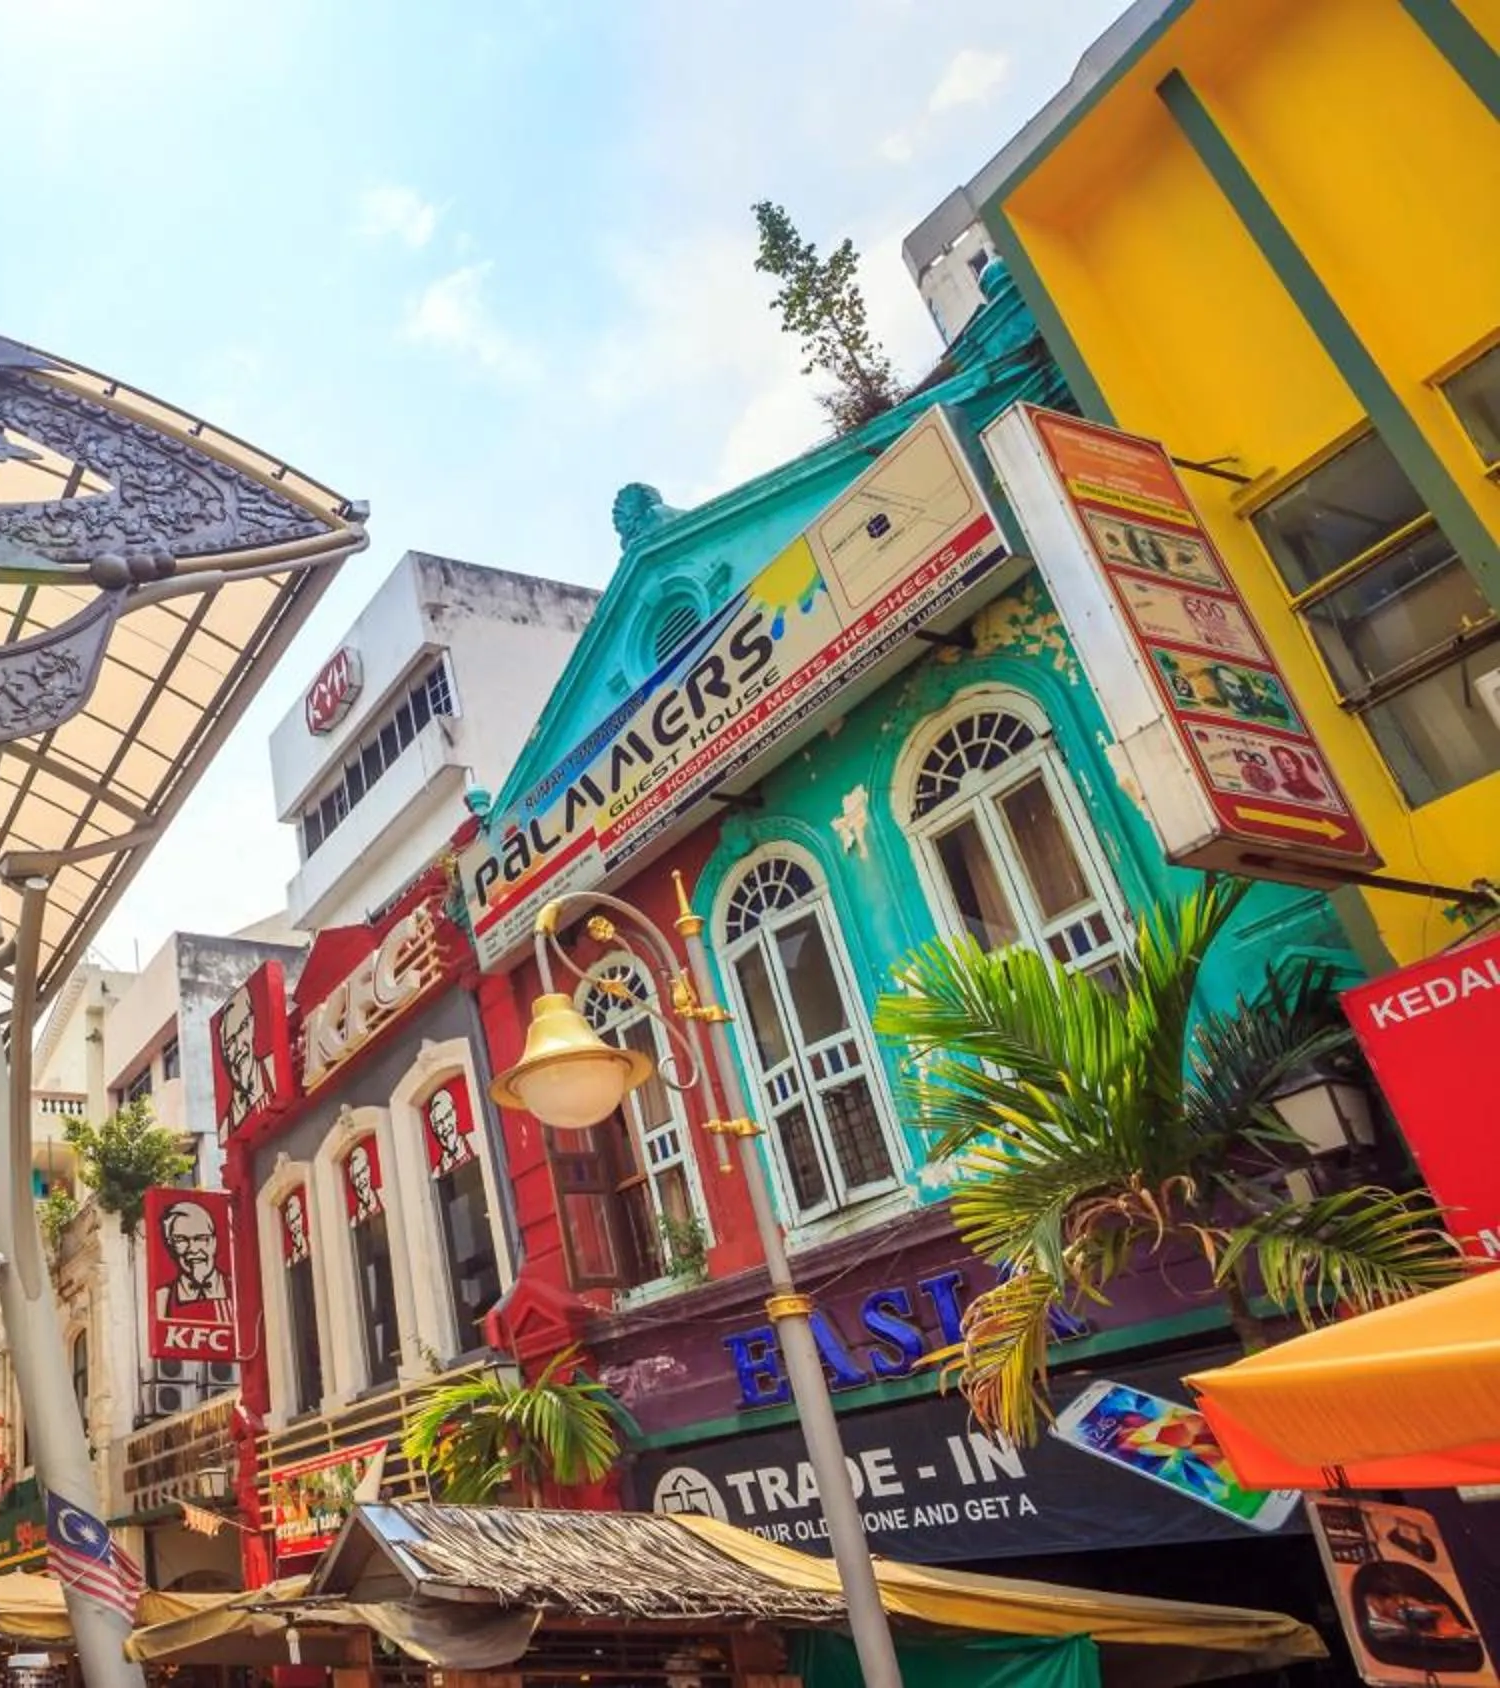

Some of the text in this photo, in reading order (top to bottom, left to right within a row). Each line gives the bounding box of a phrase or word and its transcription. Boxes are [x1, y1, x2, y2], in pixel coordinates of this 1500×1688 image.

[608, 666, 781, 818] GUEST HOUSE
[612, 789, 663, 836] WHERE
[666, 709, 765, 794] HOSPITALITY
[765, 653, 828, 711] MEETS
[833, 621, 870, 656] THE
[873, 546, 957, 620] SHEETS
[302, 908, 428, 1086] KFC
[164, 1325, 231, 1351] KFC
[947, 1432, 1027, 1485] IN
[748, 1493, 1038, 1544] OUR OLD ONE AND GET A
